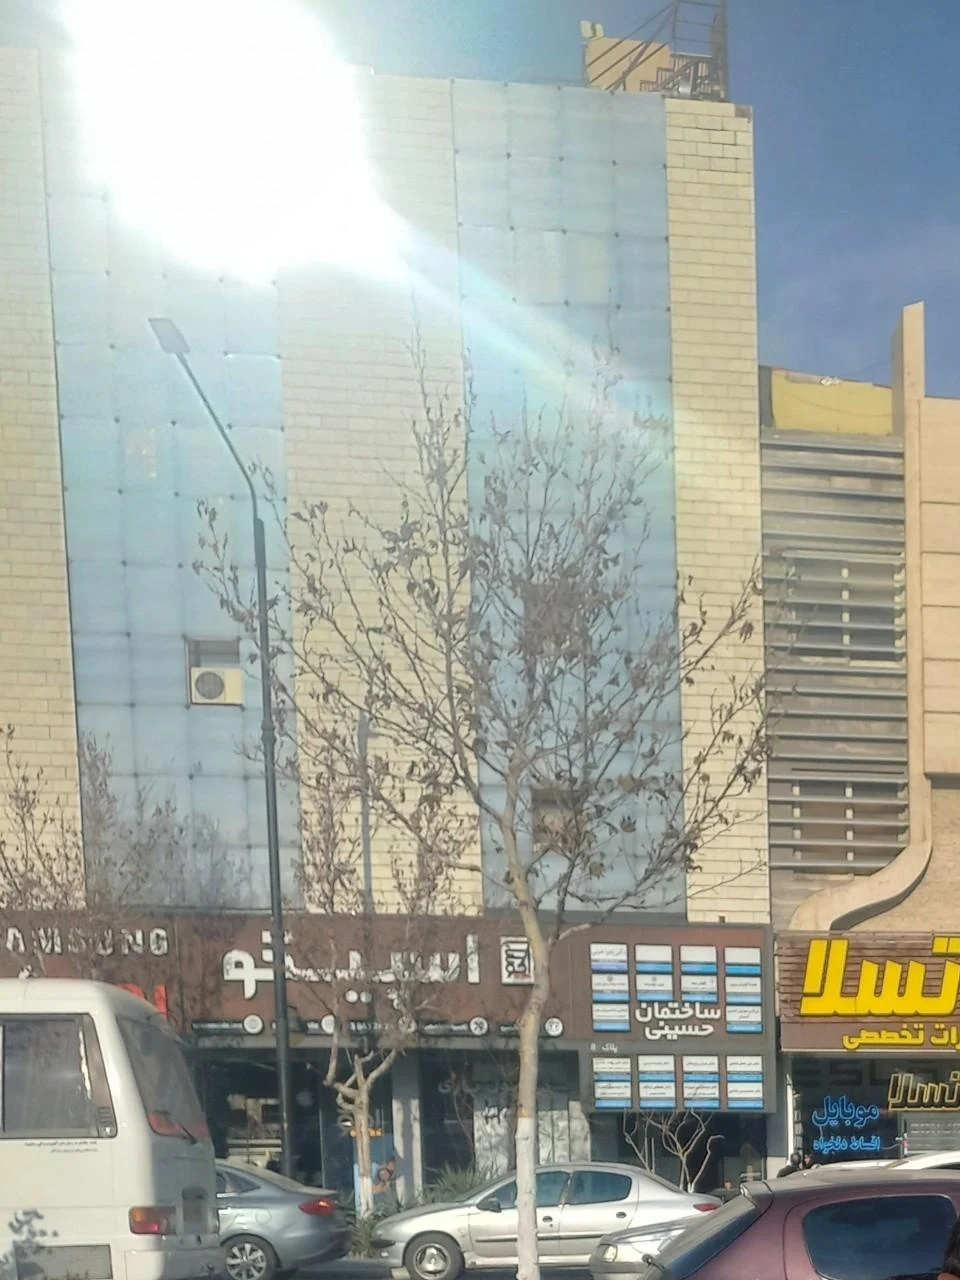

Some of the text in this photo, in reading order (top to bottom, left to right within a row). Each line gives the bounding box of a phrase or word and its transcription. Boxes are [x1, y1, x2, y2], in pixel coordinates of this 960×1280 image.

[634, 1001, 722, 1023] ساختمان
[644, 1020, 715, 1041] حسینی
[842, 1023, 925, 1051] تخصصی
[811, 1095, 881, 1128] موبایل
[813, 1135, 881, 1155] اقساط دلخواه
